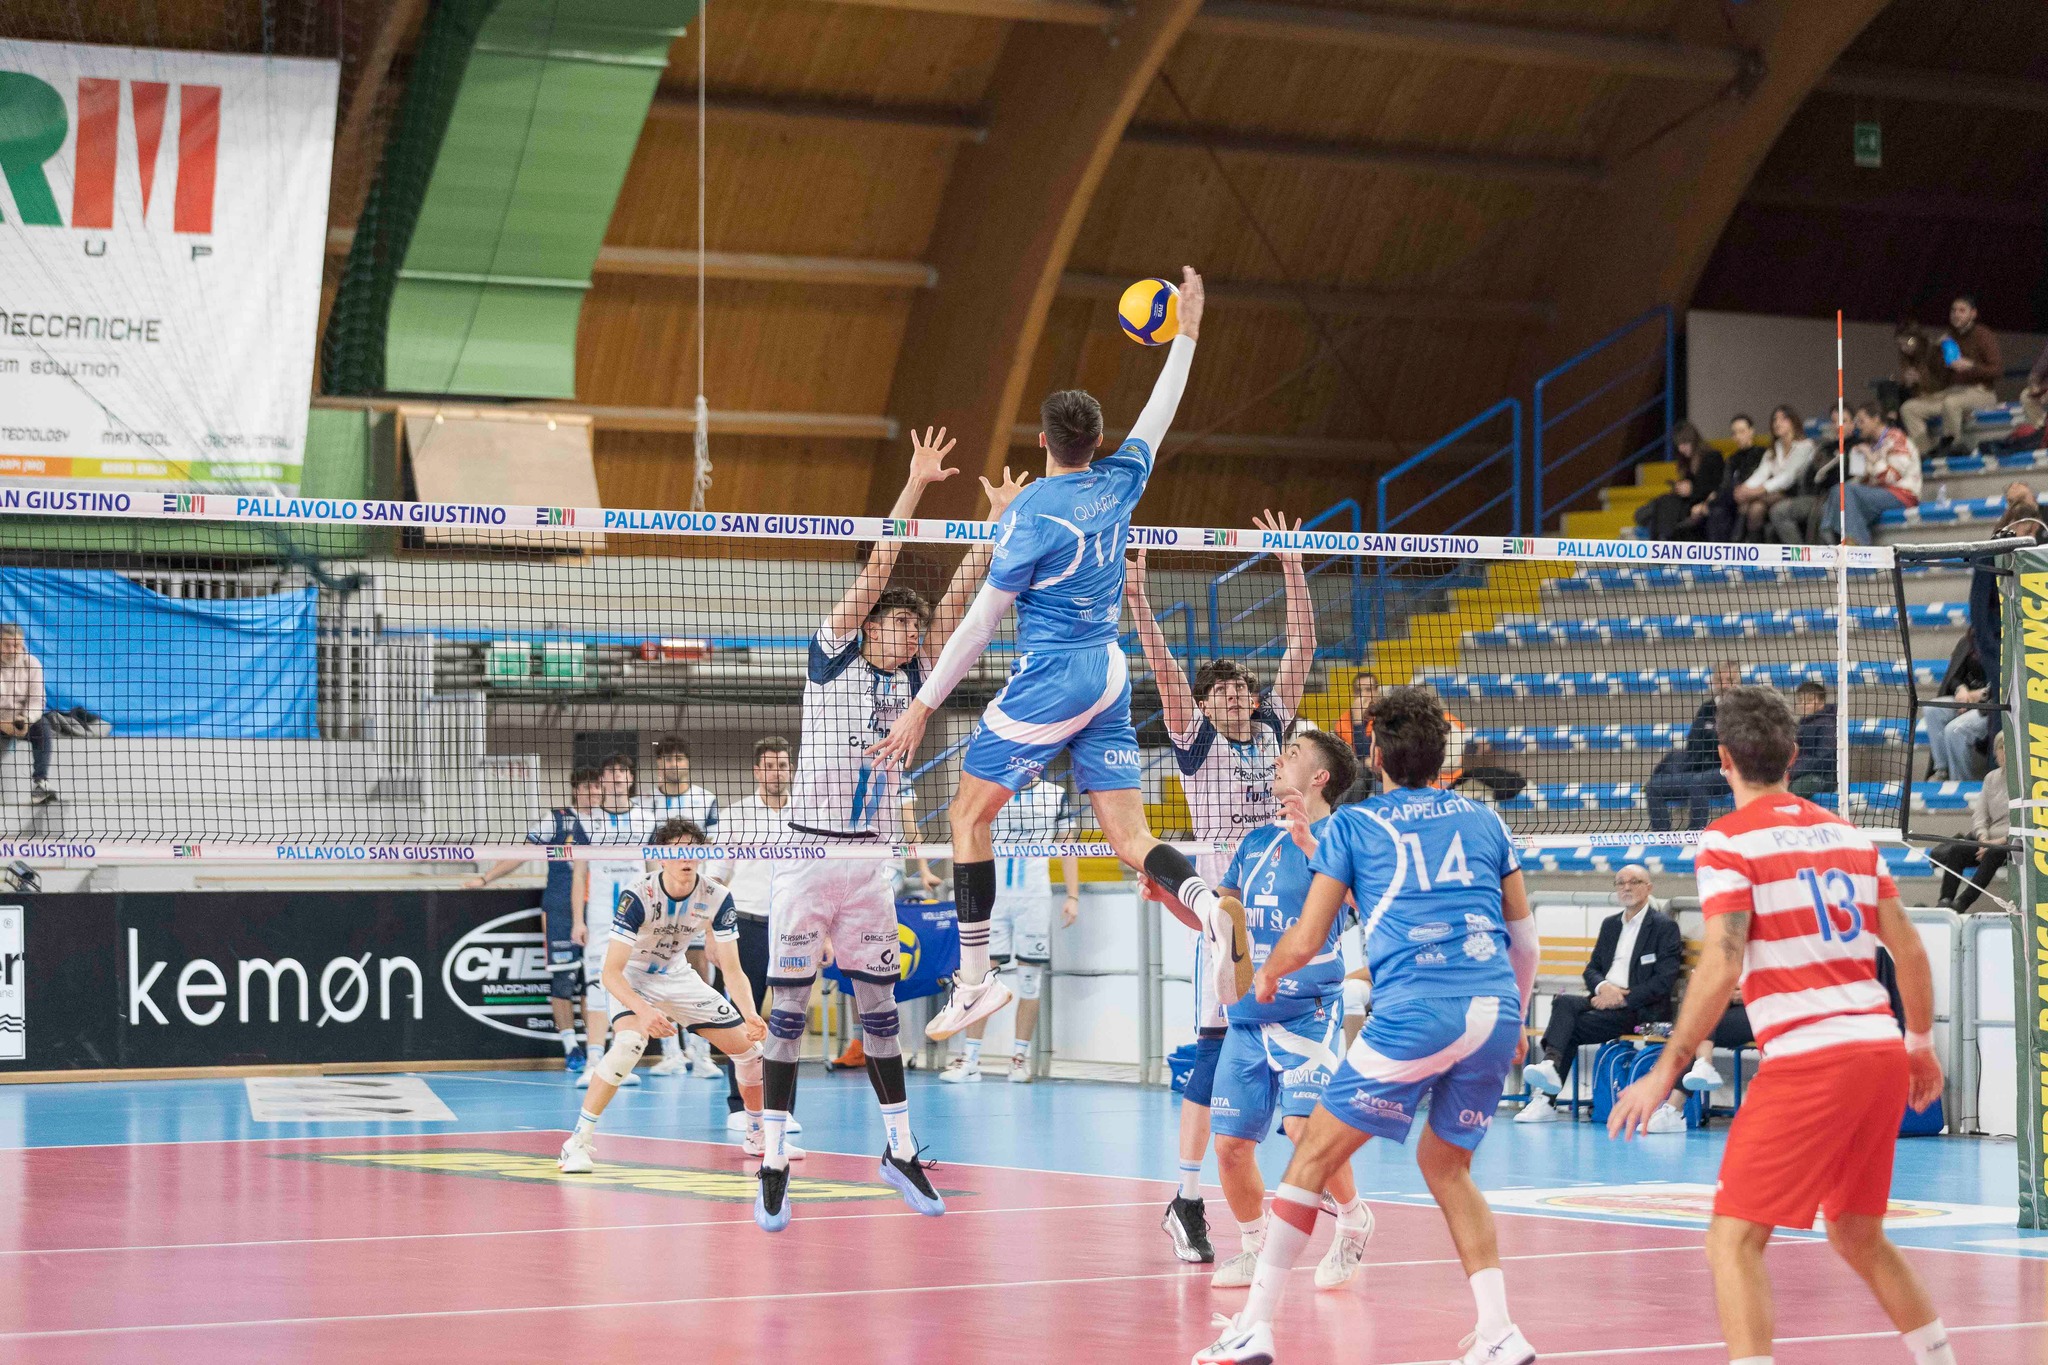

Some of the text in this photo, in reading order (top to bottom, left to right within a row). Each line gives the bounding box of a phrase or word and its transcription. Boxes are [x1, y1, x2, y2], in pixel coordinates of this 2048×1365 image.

[26, 490, 131, 512] GIUSTINO
[235, 497, 507, 526] PALLAVOLO SAN GIUSTINO
[1074, 494, 1122, 521] QUARTA
[603, 510, 855, 536] PALLAVOLO SAN GIUSTINO
[1261, 531, 1480, 554] PALLAVOLO SAN GIUSTINO
[1557, 541, 1760, 562] PALLAVOLO SAN GIUSTINO
[1060, 843, 1088, 857] SAN
[1589, 833, 1656, 846] PALLAVOLO
[1658, 832, 1683, 845] SAN
[18, 843, 96, 859] GIUSTINO
[276, 846, 475, 861] PALLAVOLO SAN GIUSTINO
[642, 846, 826, 860] PALLAVOLO SAN GIUSTINO
[1398, 829, 1476, 892] 14
[1261, 871, 1276, 895] 3
[1796, 866, 1863, 943] 13
[482, 984, 552, 995] MACCHINE
[1355, 1087, 1404, 1112] TOYOTA
